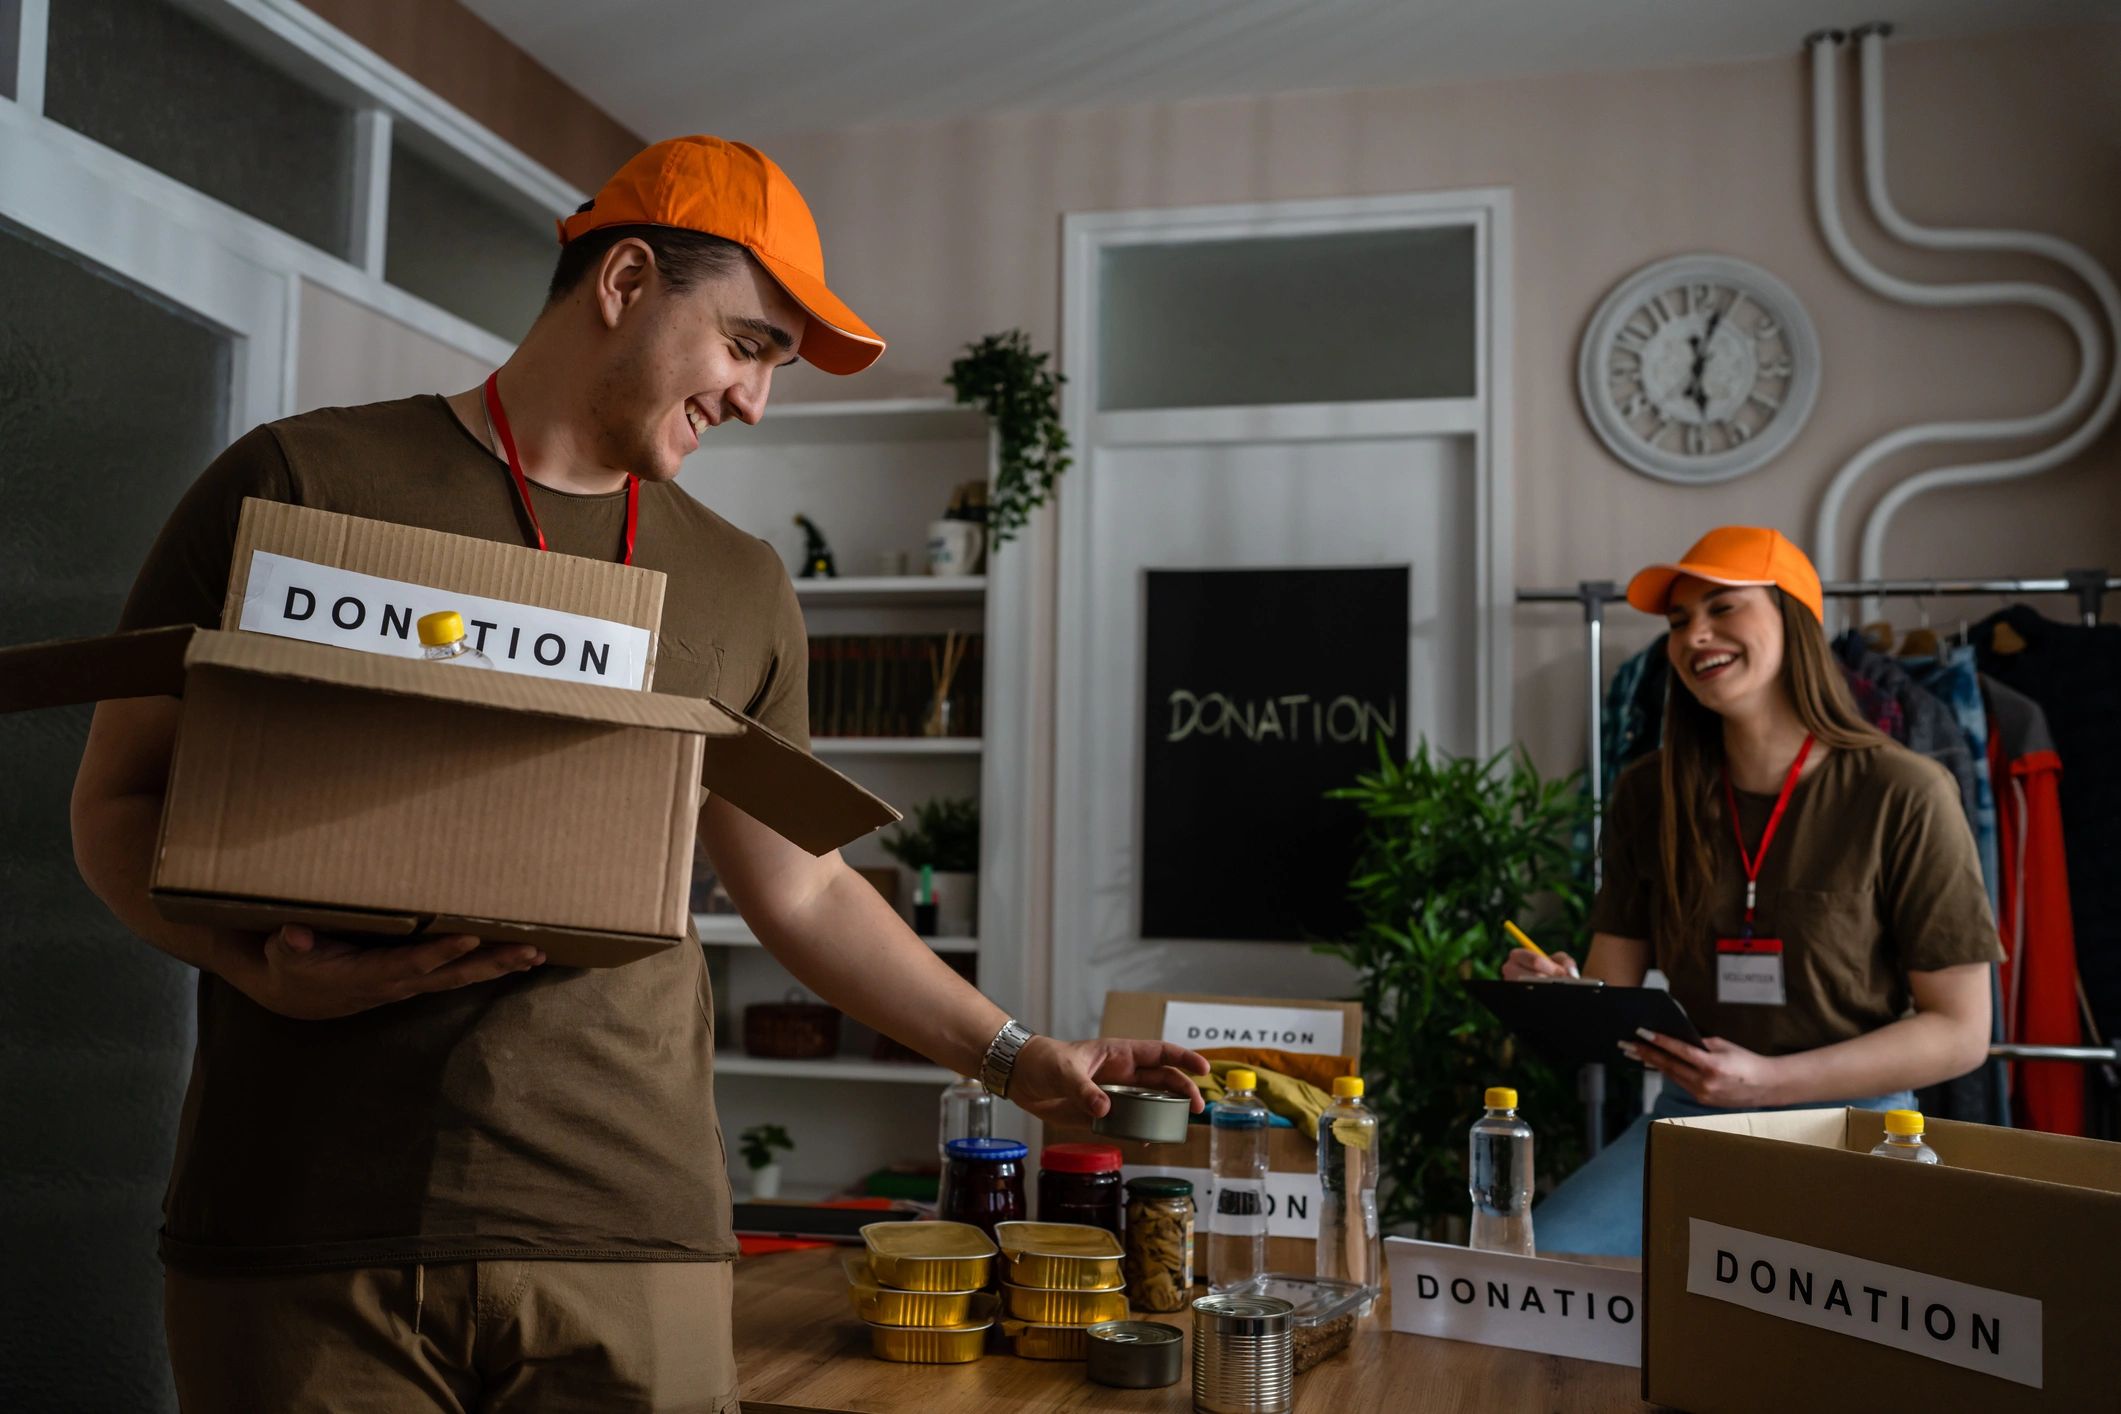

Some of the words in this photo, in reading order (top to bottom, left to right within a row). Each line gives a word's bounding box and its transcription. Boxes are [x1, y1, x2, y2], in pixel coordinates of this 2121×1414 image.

[283, 585, 610, 675] DONTION
[1167, 689, 1397, 744] DONATION
[1187, 1026, 1315, 1045] DONATION
[1416, 1273, 1636, 1325] DONATIO
[1715, 1249, 2001, 1355] DONATION
